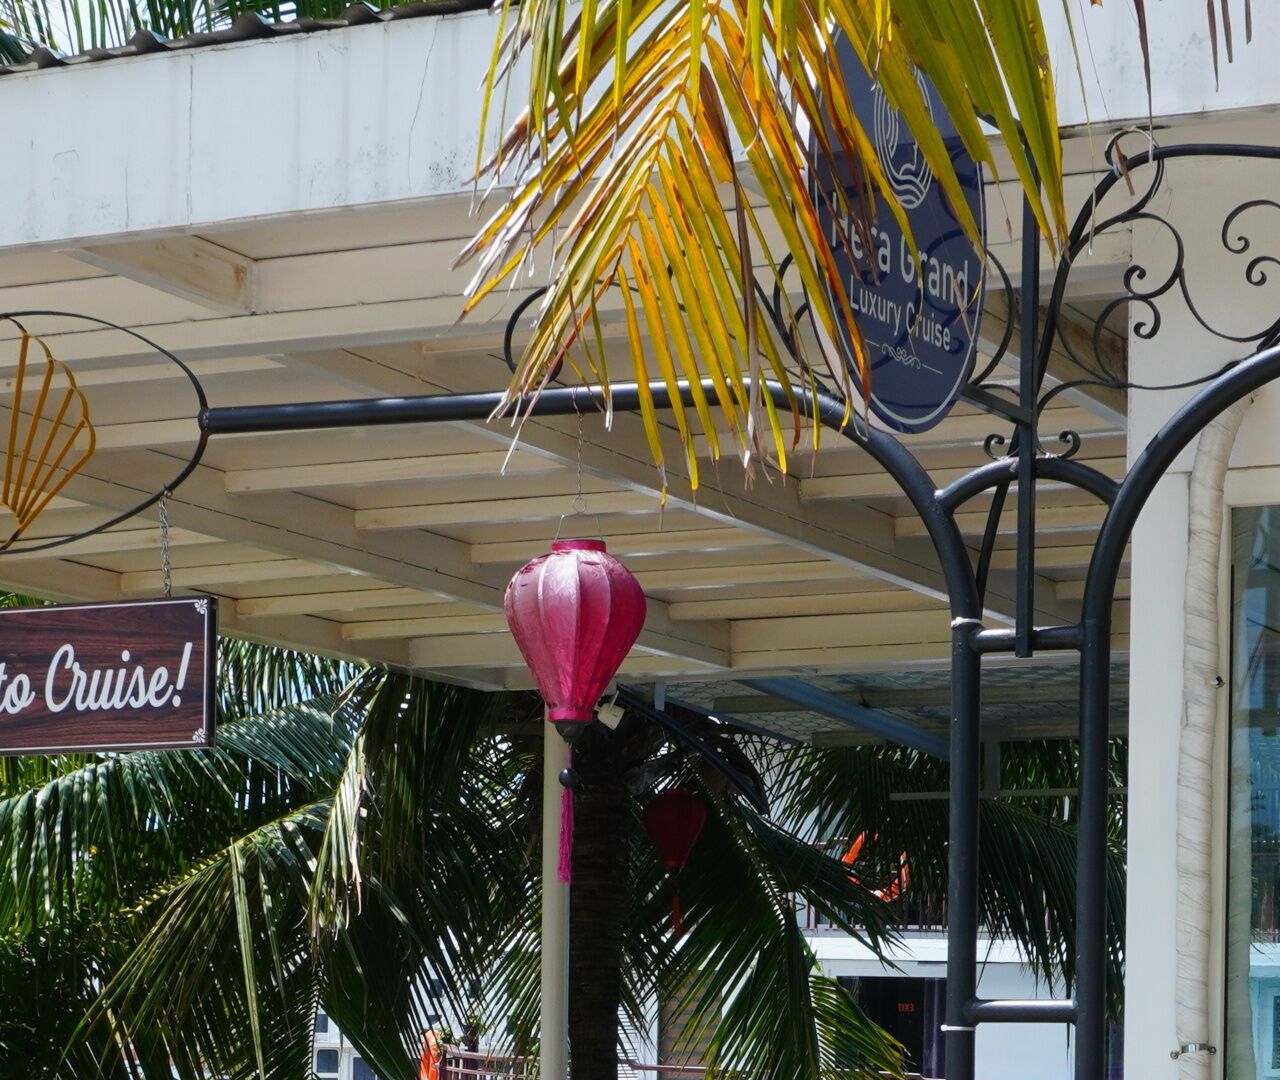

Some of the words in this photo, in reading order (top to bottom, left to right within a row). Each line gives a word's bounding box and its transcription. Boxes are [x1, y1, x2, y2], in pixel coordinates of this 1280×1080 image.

[900, 233, 968, 307] Grand
[850, 273, 901, 336] Luxury
[905, 301, 951, 351] Cruise
[45, 642, 193, 713] Cruise!
